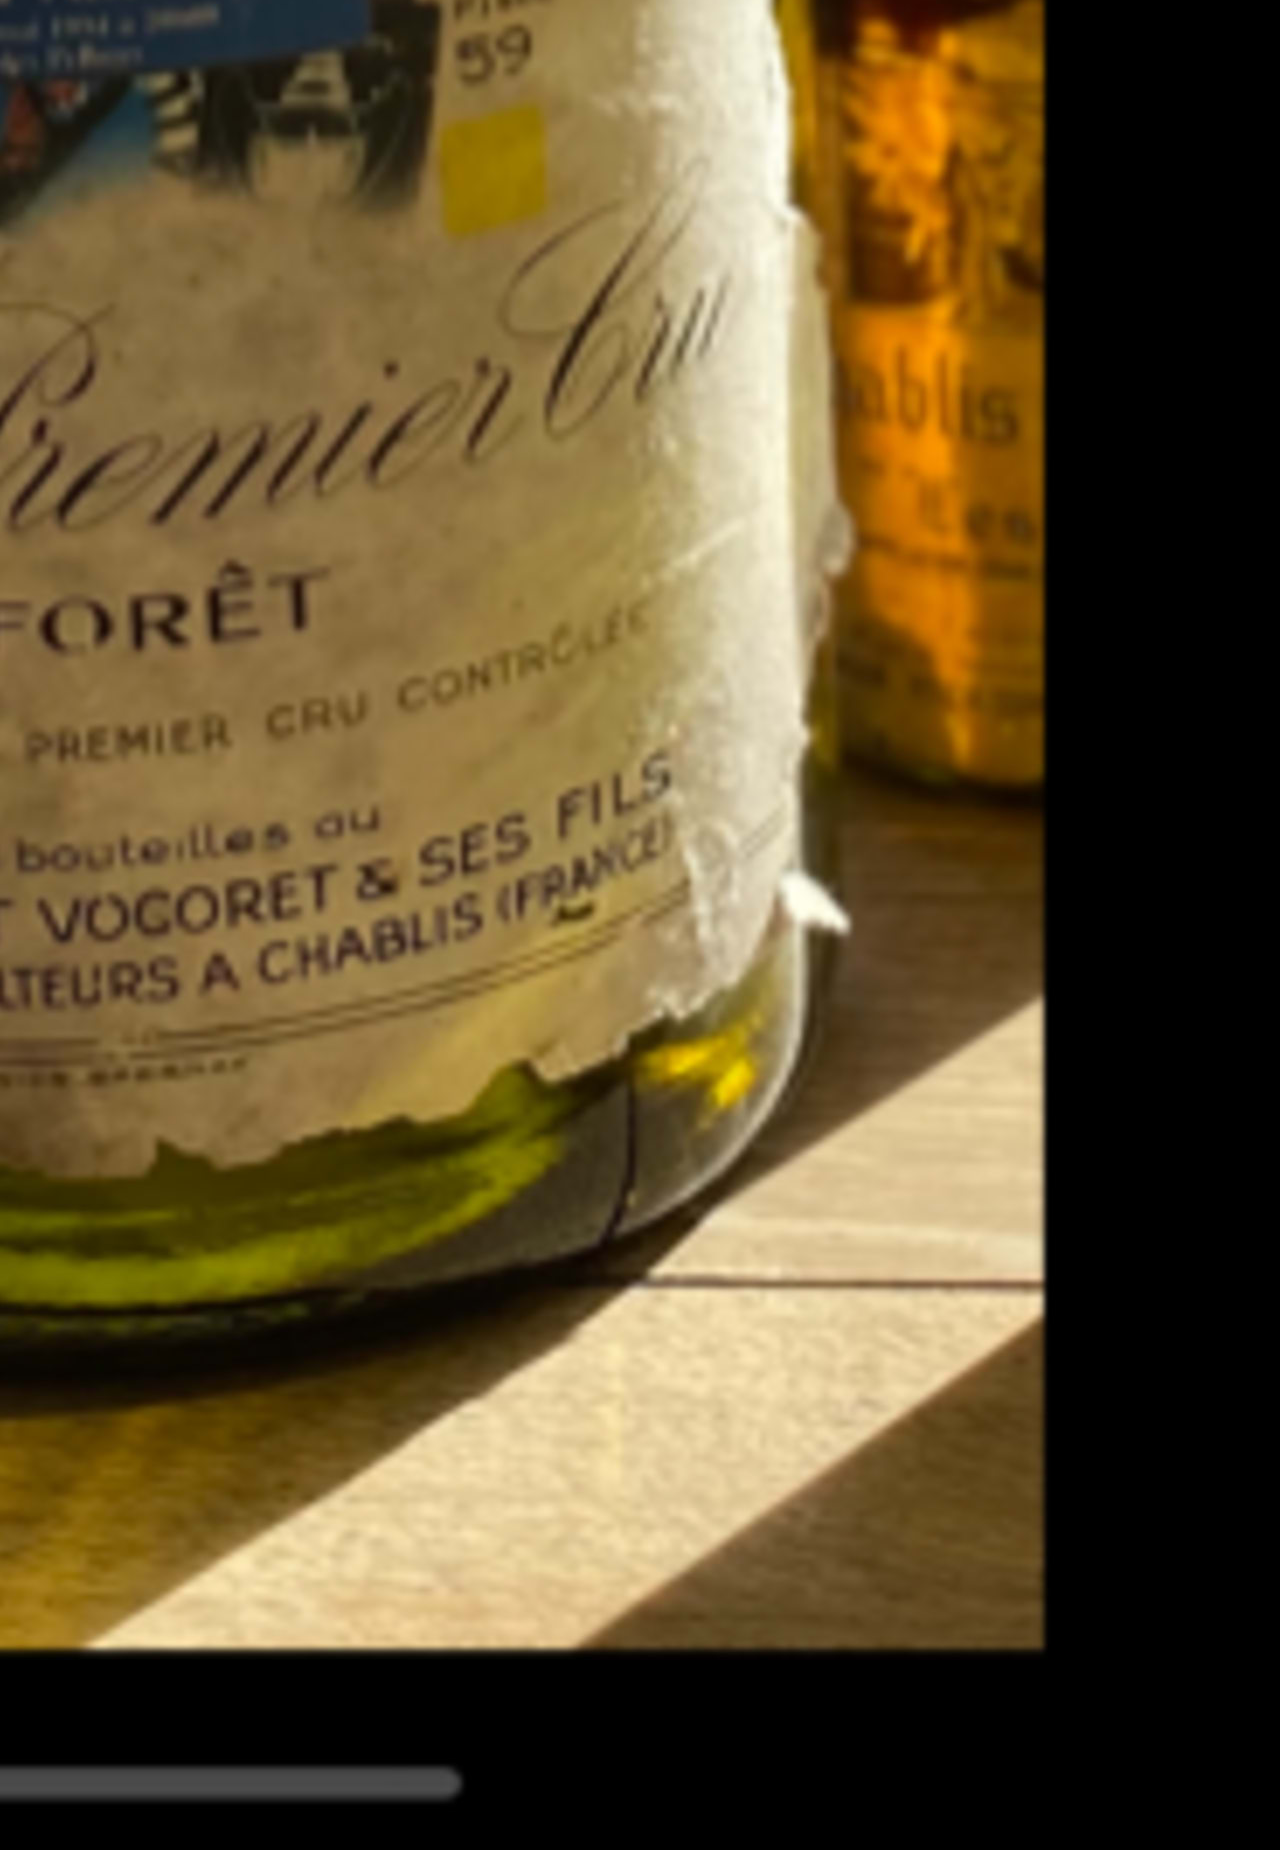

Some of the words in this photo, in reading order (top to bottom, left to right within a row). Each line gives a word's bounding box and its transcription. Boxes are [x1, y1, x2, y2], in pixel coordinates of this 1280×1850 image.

[455, 23, 532, 88] 59
[498, 155, 734, 442] Cru
[26, 716, 234, 763] PREMIER
[266, 691, 369, 740] CRU
[15, 822, 291, 876] bouteilles
[314, 806, 381, 839] au
[356, 858, 400, 902] &
[419, 811, 533, 887] SES
[557, 751, 673, 839] FILS
[200, 952, 240, 994] A
[257, 891, 483, 987] CHABLIS
